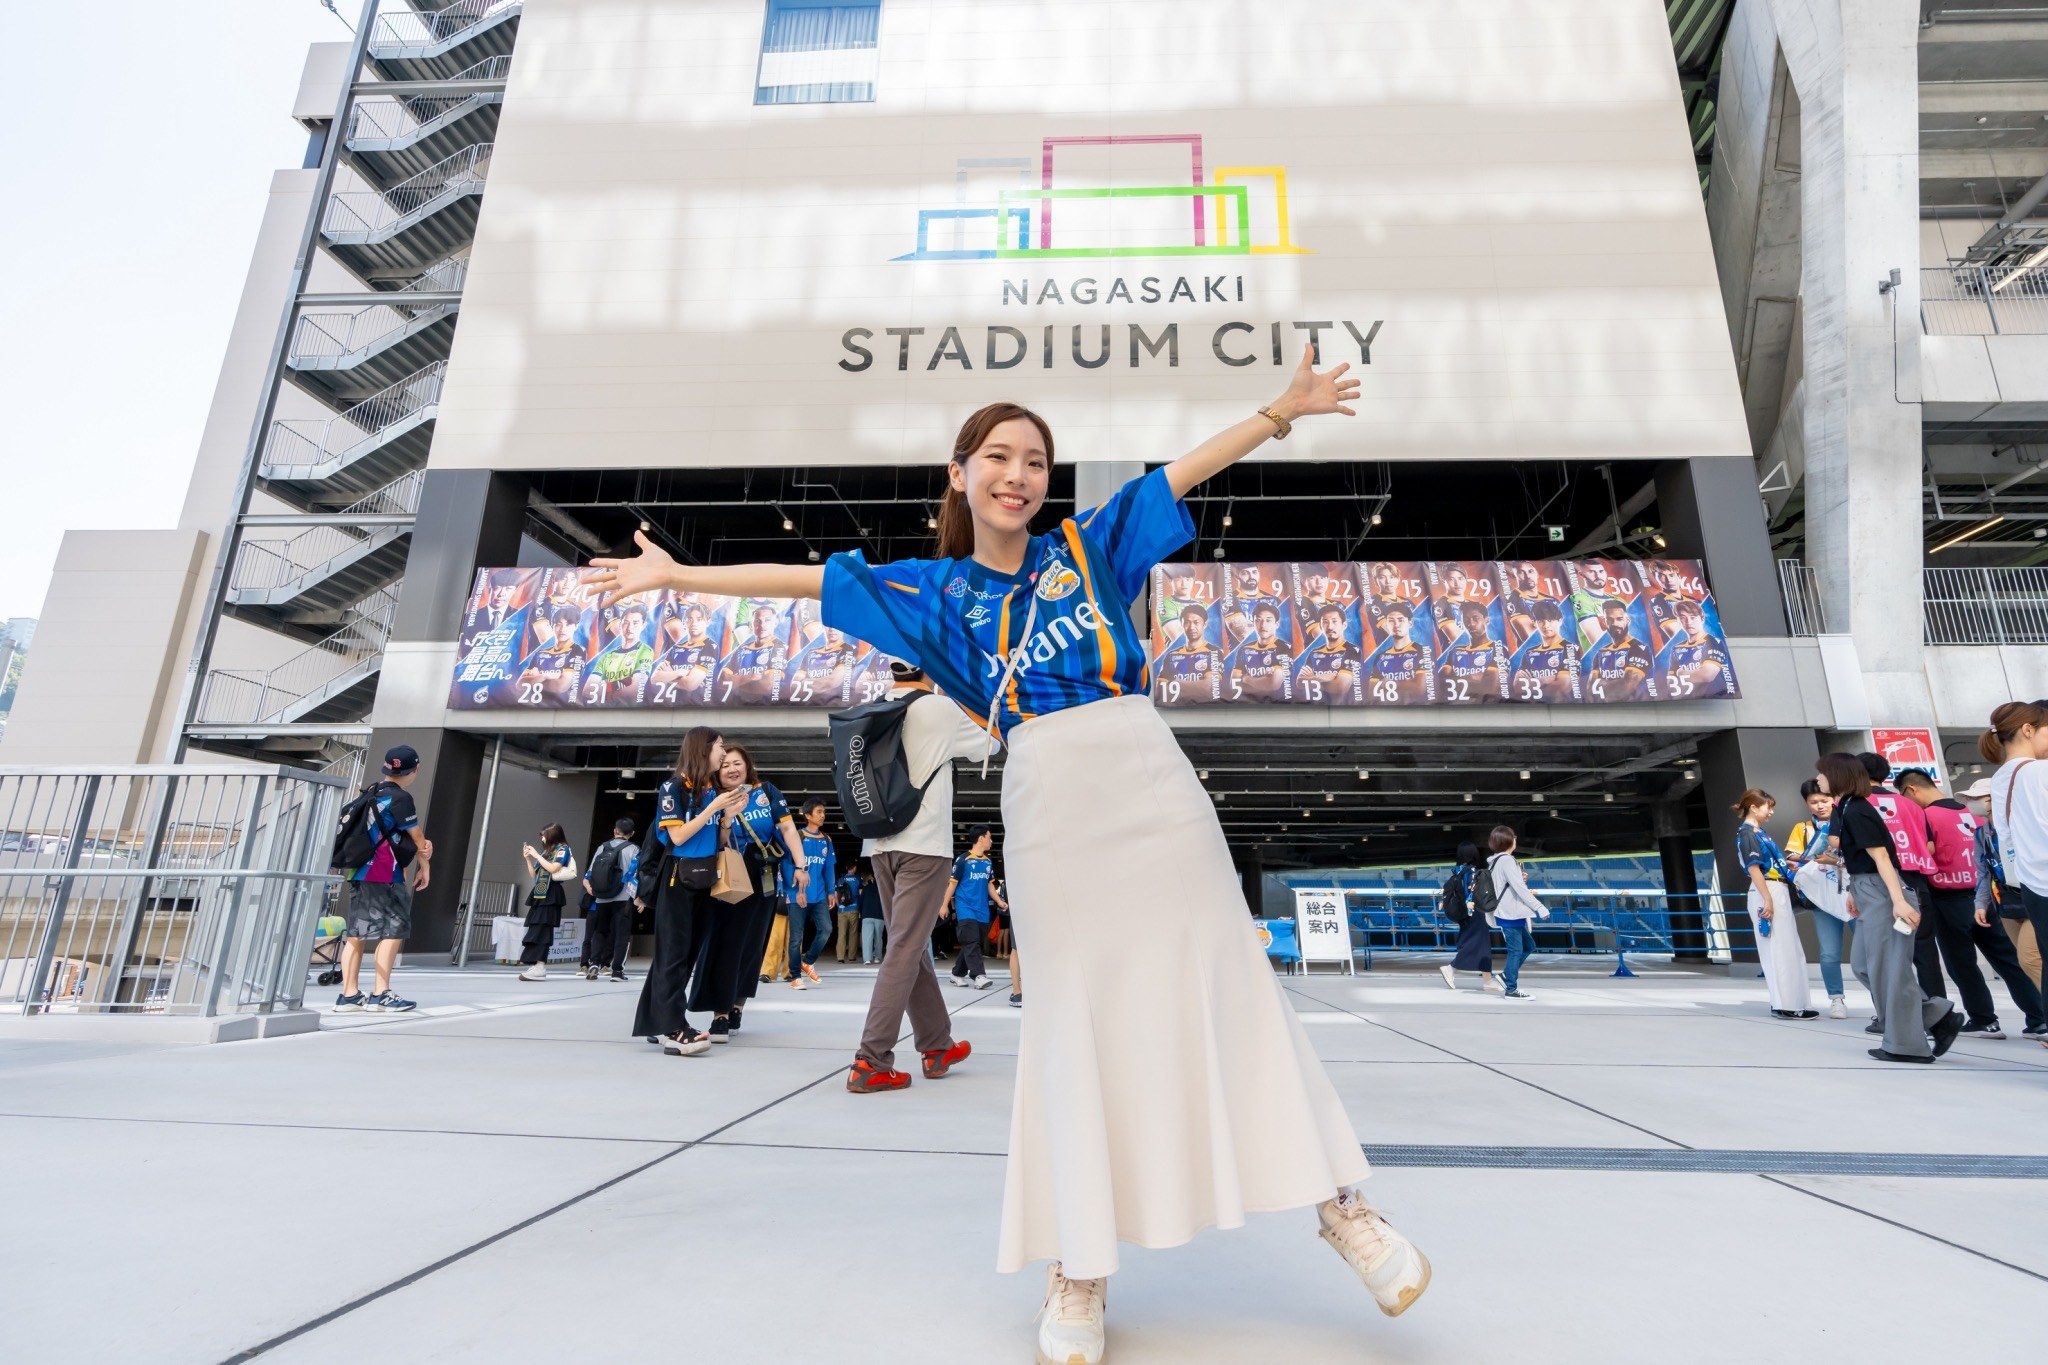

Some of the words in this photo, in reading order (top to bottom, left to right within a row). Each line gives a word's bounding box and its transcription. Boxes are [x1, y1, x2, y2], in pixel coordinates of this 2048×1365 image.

[1002, 275, 1245, 306] NAGASAKI
[838, 322, 1178, 372] STADIUM
[1211, 319, 1384, 368] CITY
[1194, 581, 1214, 599] 21
[1271, 580, 1283, 597] 9
[1330, 580, 1352, 599] 22
[1402, 579, 1422, 597] 15
[1467, 579, 1491, 597] 29
[1544, 578, 1563, 596] 11
[1607, 577, 1633, 595] 30
[1680, 576, 1704, 595] 44
[970, 617, 992, 629] umbro
[464, 646, 512, 664] 最高の
[518, 683, 543, 703] 28
[587, 683, 607, 704] 31
[654, 682, 678, 703] 24
[721, 681, 733, 703] 7
[789, 681, 814, 702] 25
[861, 681, 885, 702] 38
[1160, 681, 1180, 703] 19
[1231, 678, 1242, 700] 5
[1302, 680, 1322, 701] 13
[1353, 686, 1362, 700] KATO
[1373, 680, 1399, 702] 48
[1445, 679, 1470, 701] 32
[1500, 684, 1509, 698] DIOP
[1519, 678, 1543, 700] 33
[1592, 679, 1605, 699] 4
[1645, 677, 1657, 697] VALDO
[1667, 675, 1694, 697] 35
[846, 735, 874, 814] umbro
[1933, 871, 1972, 883] CLUB
[1306, 901, 1336, 916] 総合
[1308, 919, 1339, 934] 案内
